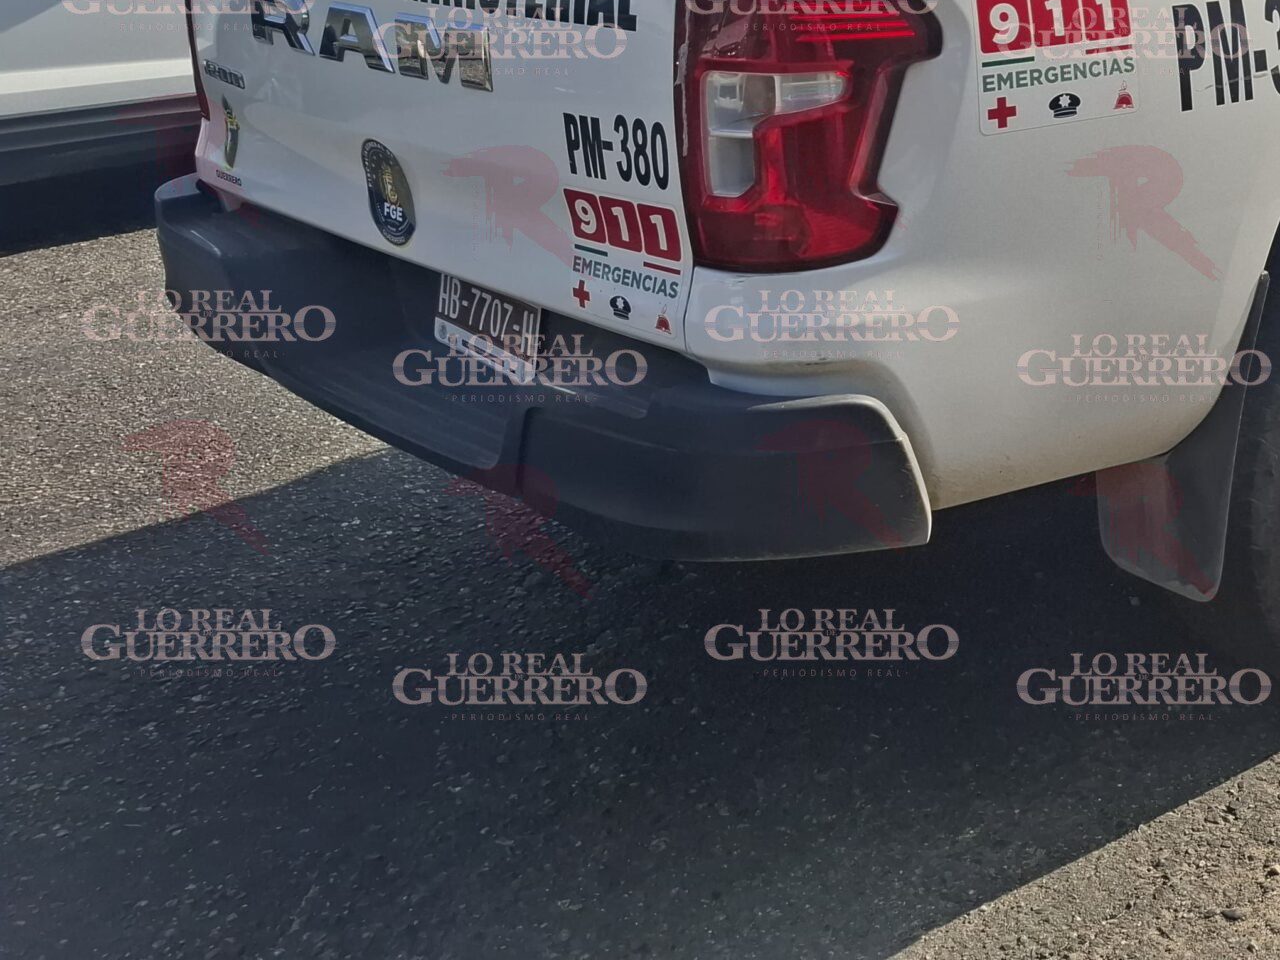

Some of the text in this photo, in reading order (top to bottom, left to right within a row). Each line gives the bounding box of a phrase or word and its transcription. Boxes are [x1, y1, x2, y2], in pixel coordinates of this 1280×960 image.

[982, 57, 1135, 93] EMERGENCIAS
[563, 113, 669, 190] PM-380
[383, 201, 403, 222] FGE
[574, 198, 669, 251] 911
[572, 255, 680, 299] EMERGENCIAS
